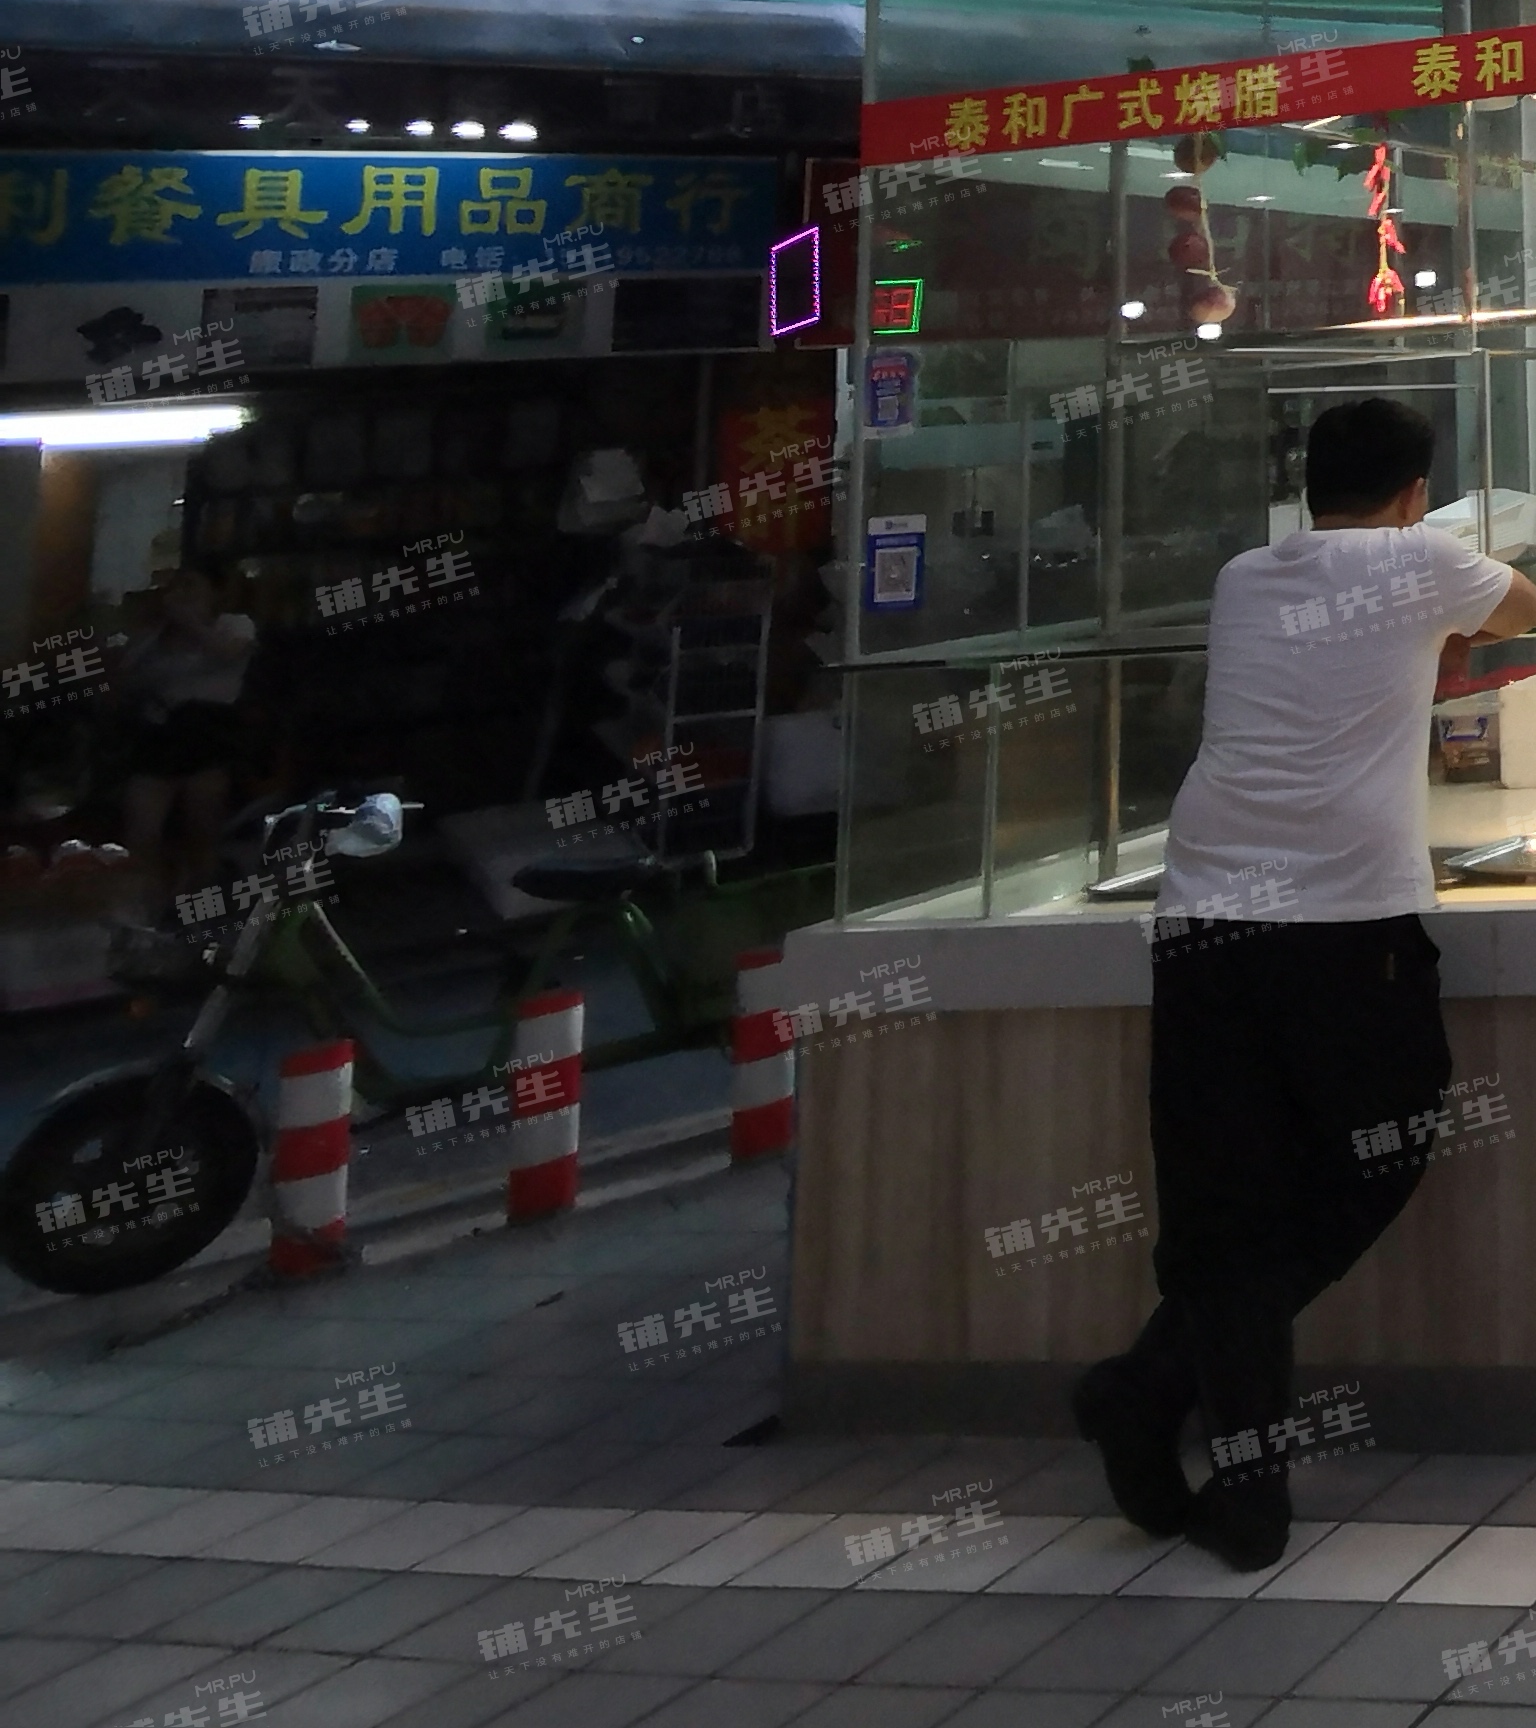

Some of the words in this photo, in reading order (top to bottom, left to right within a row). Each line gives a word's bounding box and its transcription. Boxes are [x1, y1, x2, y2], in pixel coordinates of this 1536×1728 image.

[944, 64, 1283, 152] 泰和广式烧腊
